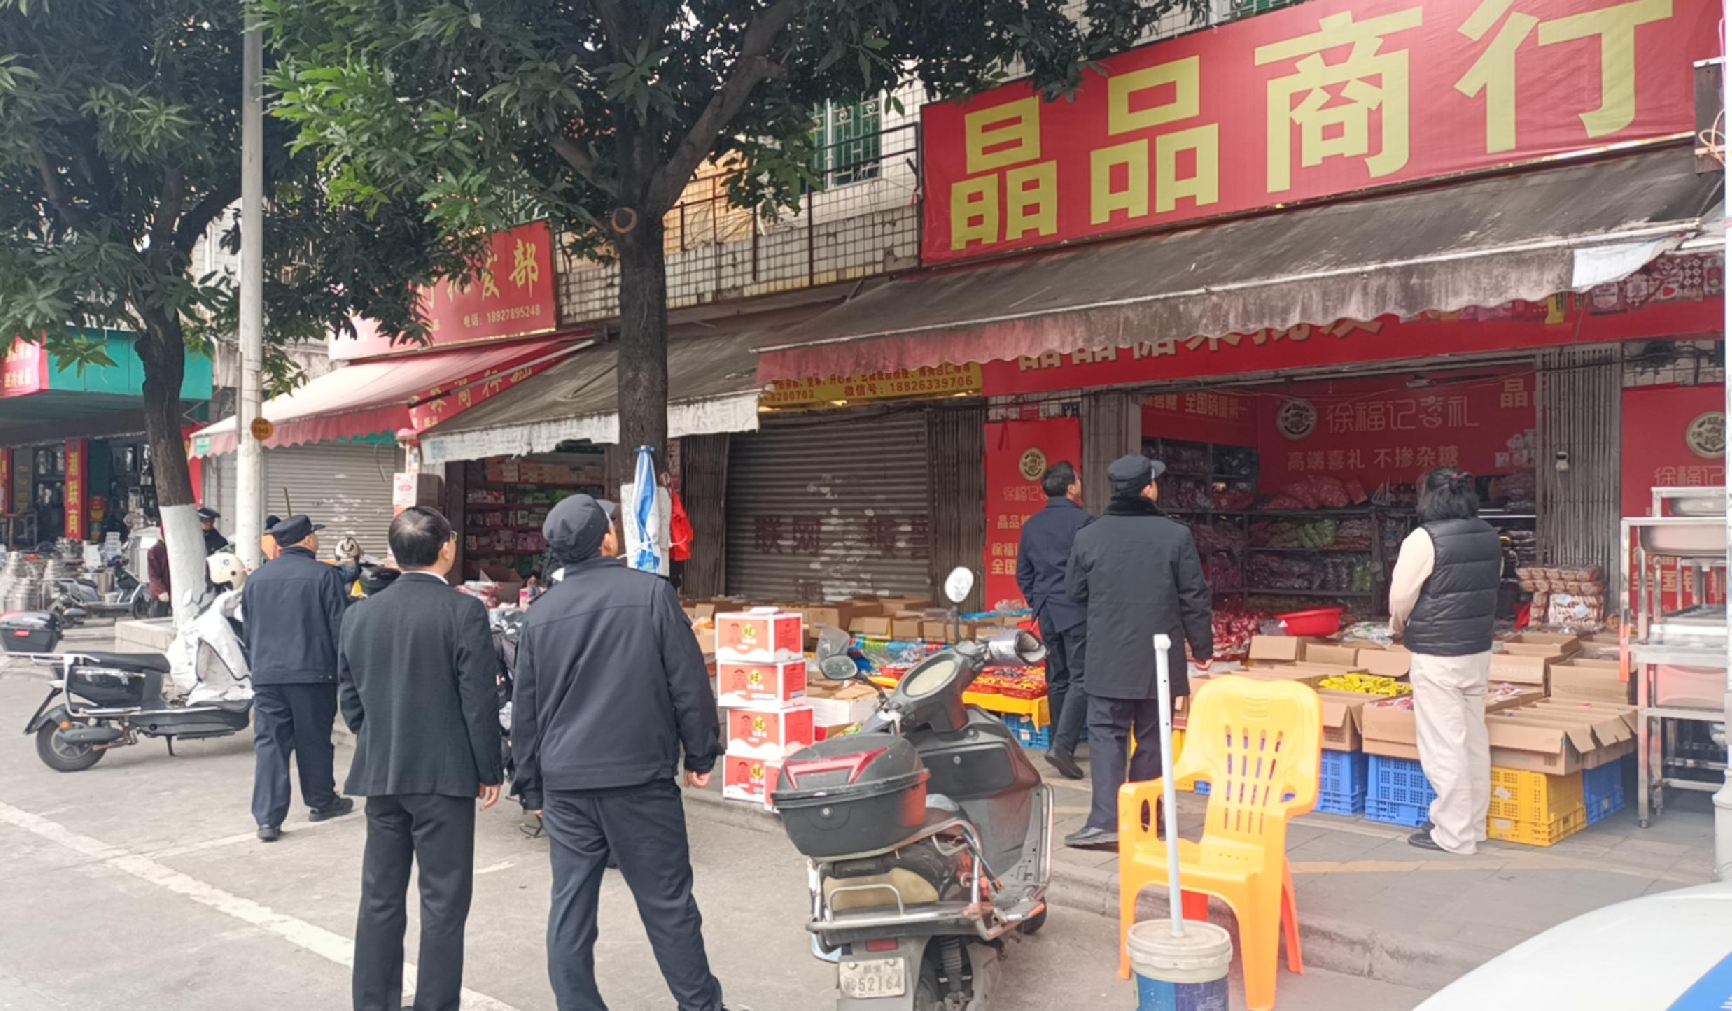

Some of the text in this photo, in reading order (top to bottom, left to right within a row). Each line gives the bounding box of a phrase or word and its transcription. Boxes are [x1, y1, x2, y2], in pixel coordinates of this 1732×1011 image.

[950, 0, 1675, 250] 晶品商行
[486, 303, 541, 324] 18927895248
[889, 377, 974, 393] 18826339706
[857, 974, 902, 993] 52164
